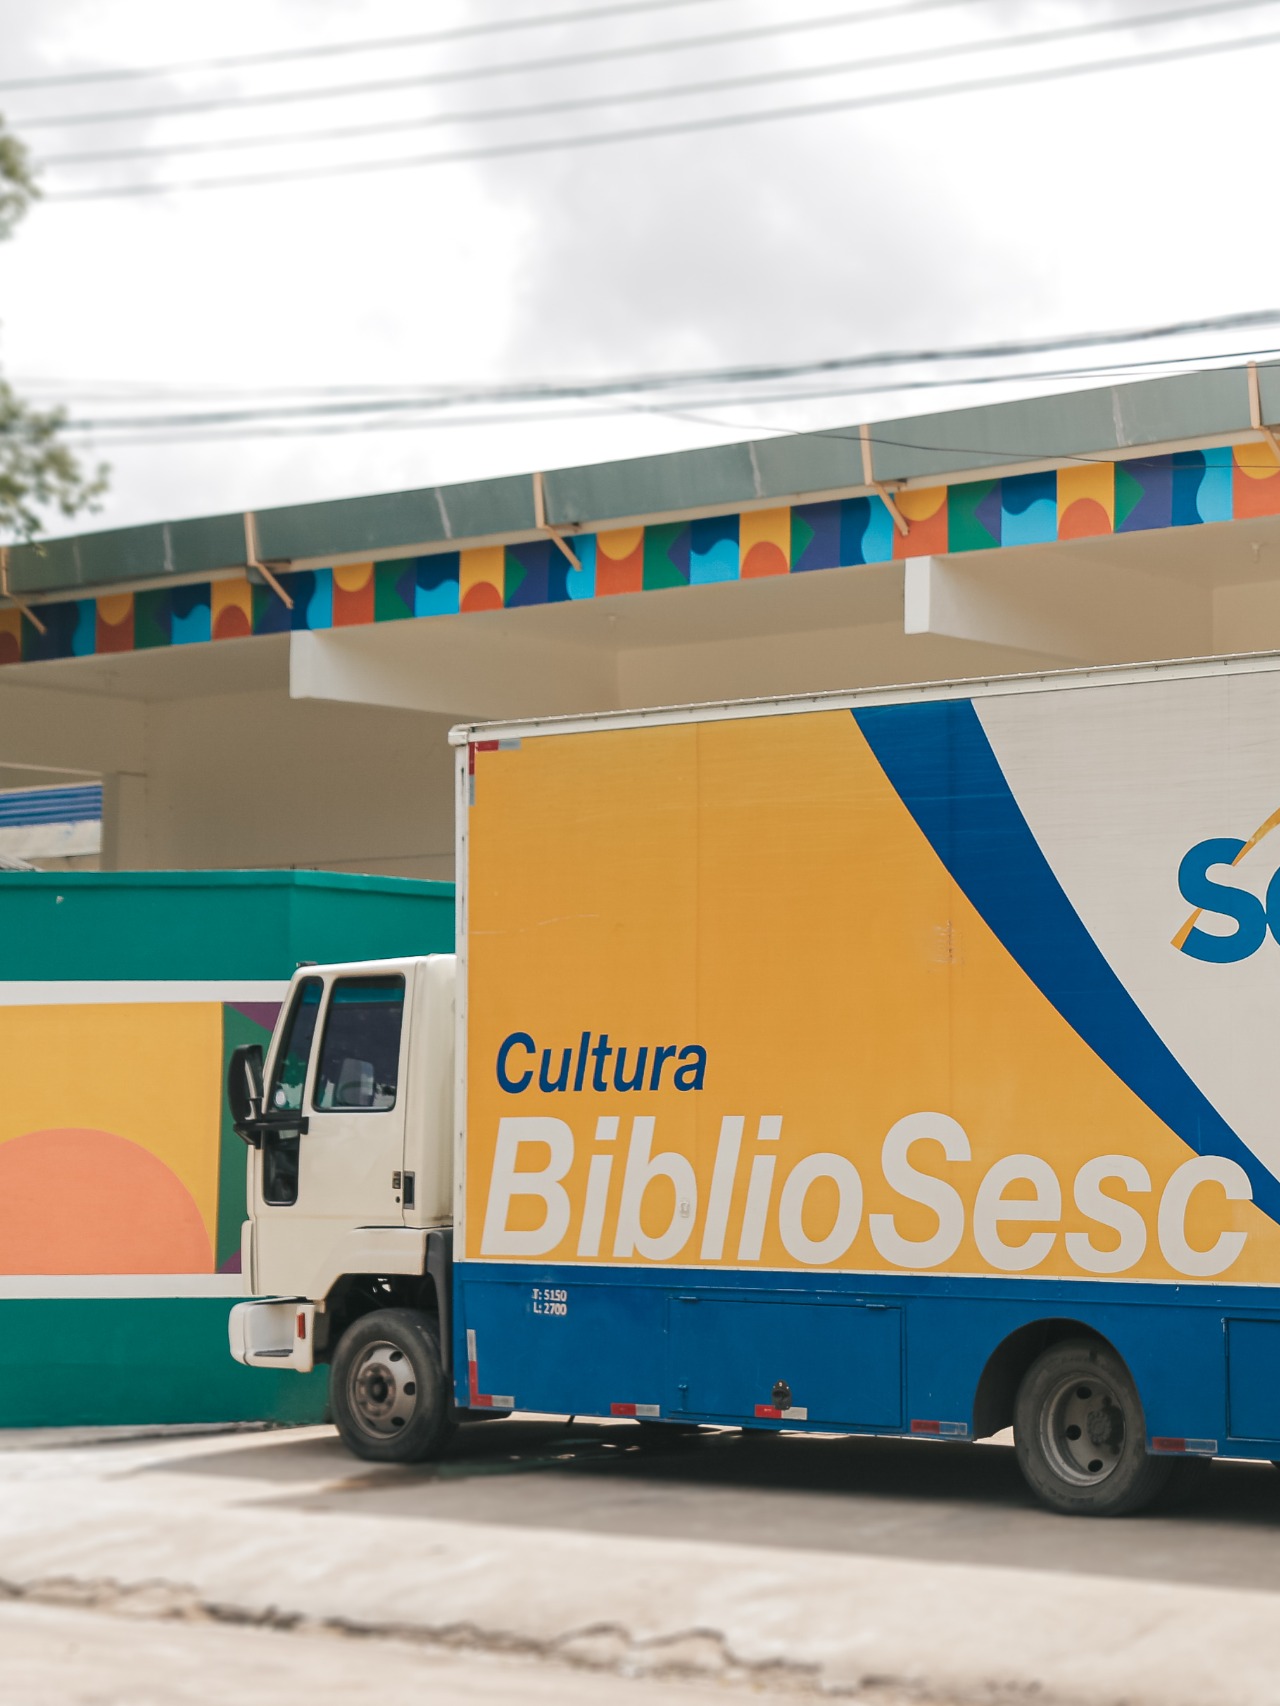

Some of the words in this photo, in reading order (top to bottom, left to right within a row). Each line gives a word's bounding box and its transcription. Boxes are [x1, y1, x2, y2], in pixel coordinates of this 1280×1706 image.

[495, 1031, 707, 1094] Cultura
[480, 1111, 1253, 1277] BiblioSesc
[533, 1301, 542, 1313] L:
[544, 1303, 567, 1315] 2700
[544, 1289, 567, 1301] 5150
